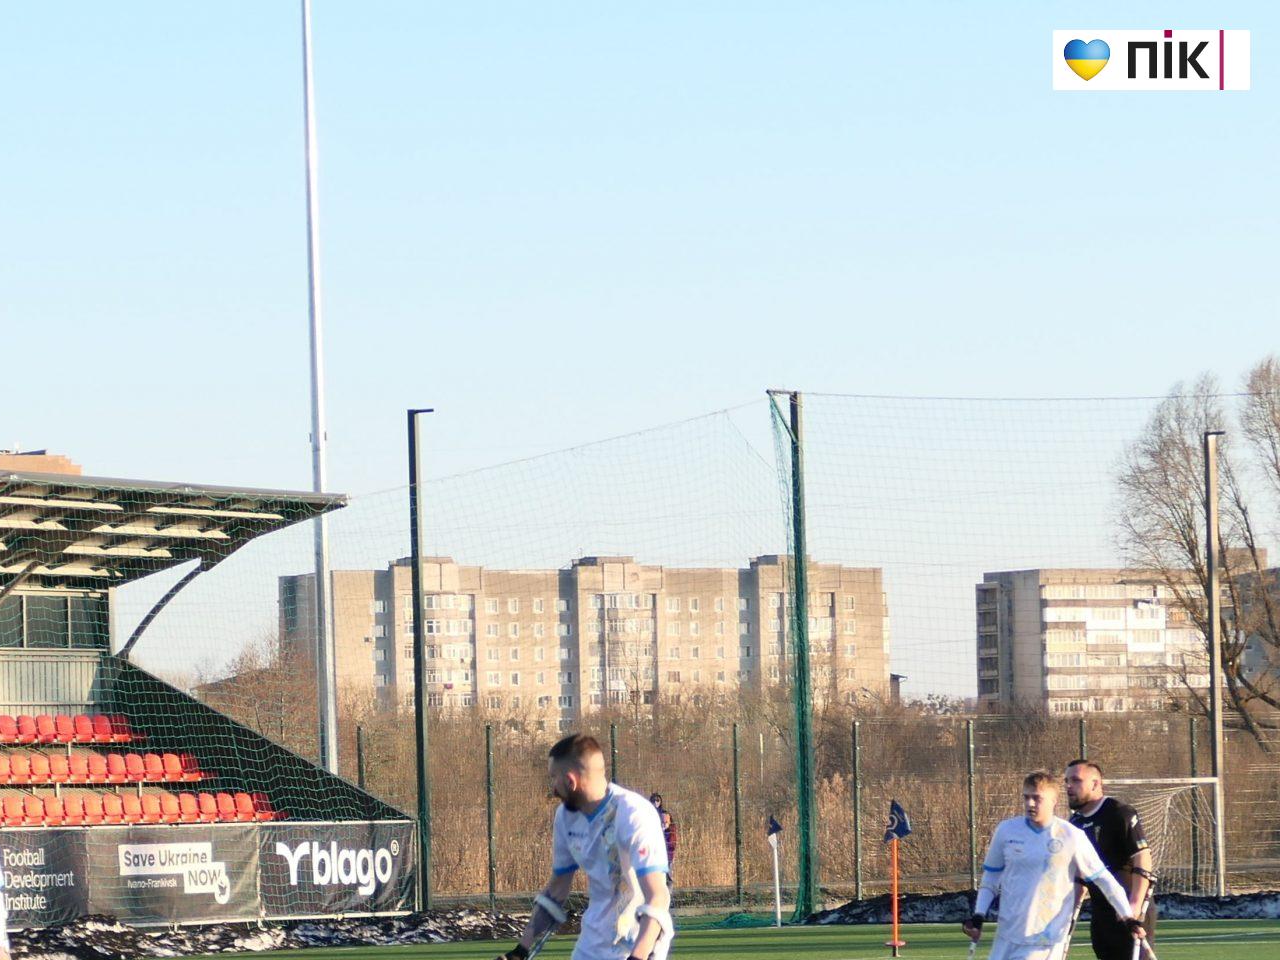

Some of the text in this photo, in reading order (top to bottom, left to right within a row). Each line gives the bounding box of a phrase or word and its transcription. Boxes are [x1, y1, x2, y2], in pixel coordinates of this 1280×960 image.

[3, 848, 45, 867] Football
[124, 848, 207, 867] Save Ukraine
[4, 870, 74, 891] Development
[188, 869, 221, 886] NOW
[5, 893, 47, 911] Institute
